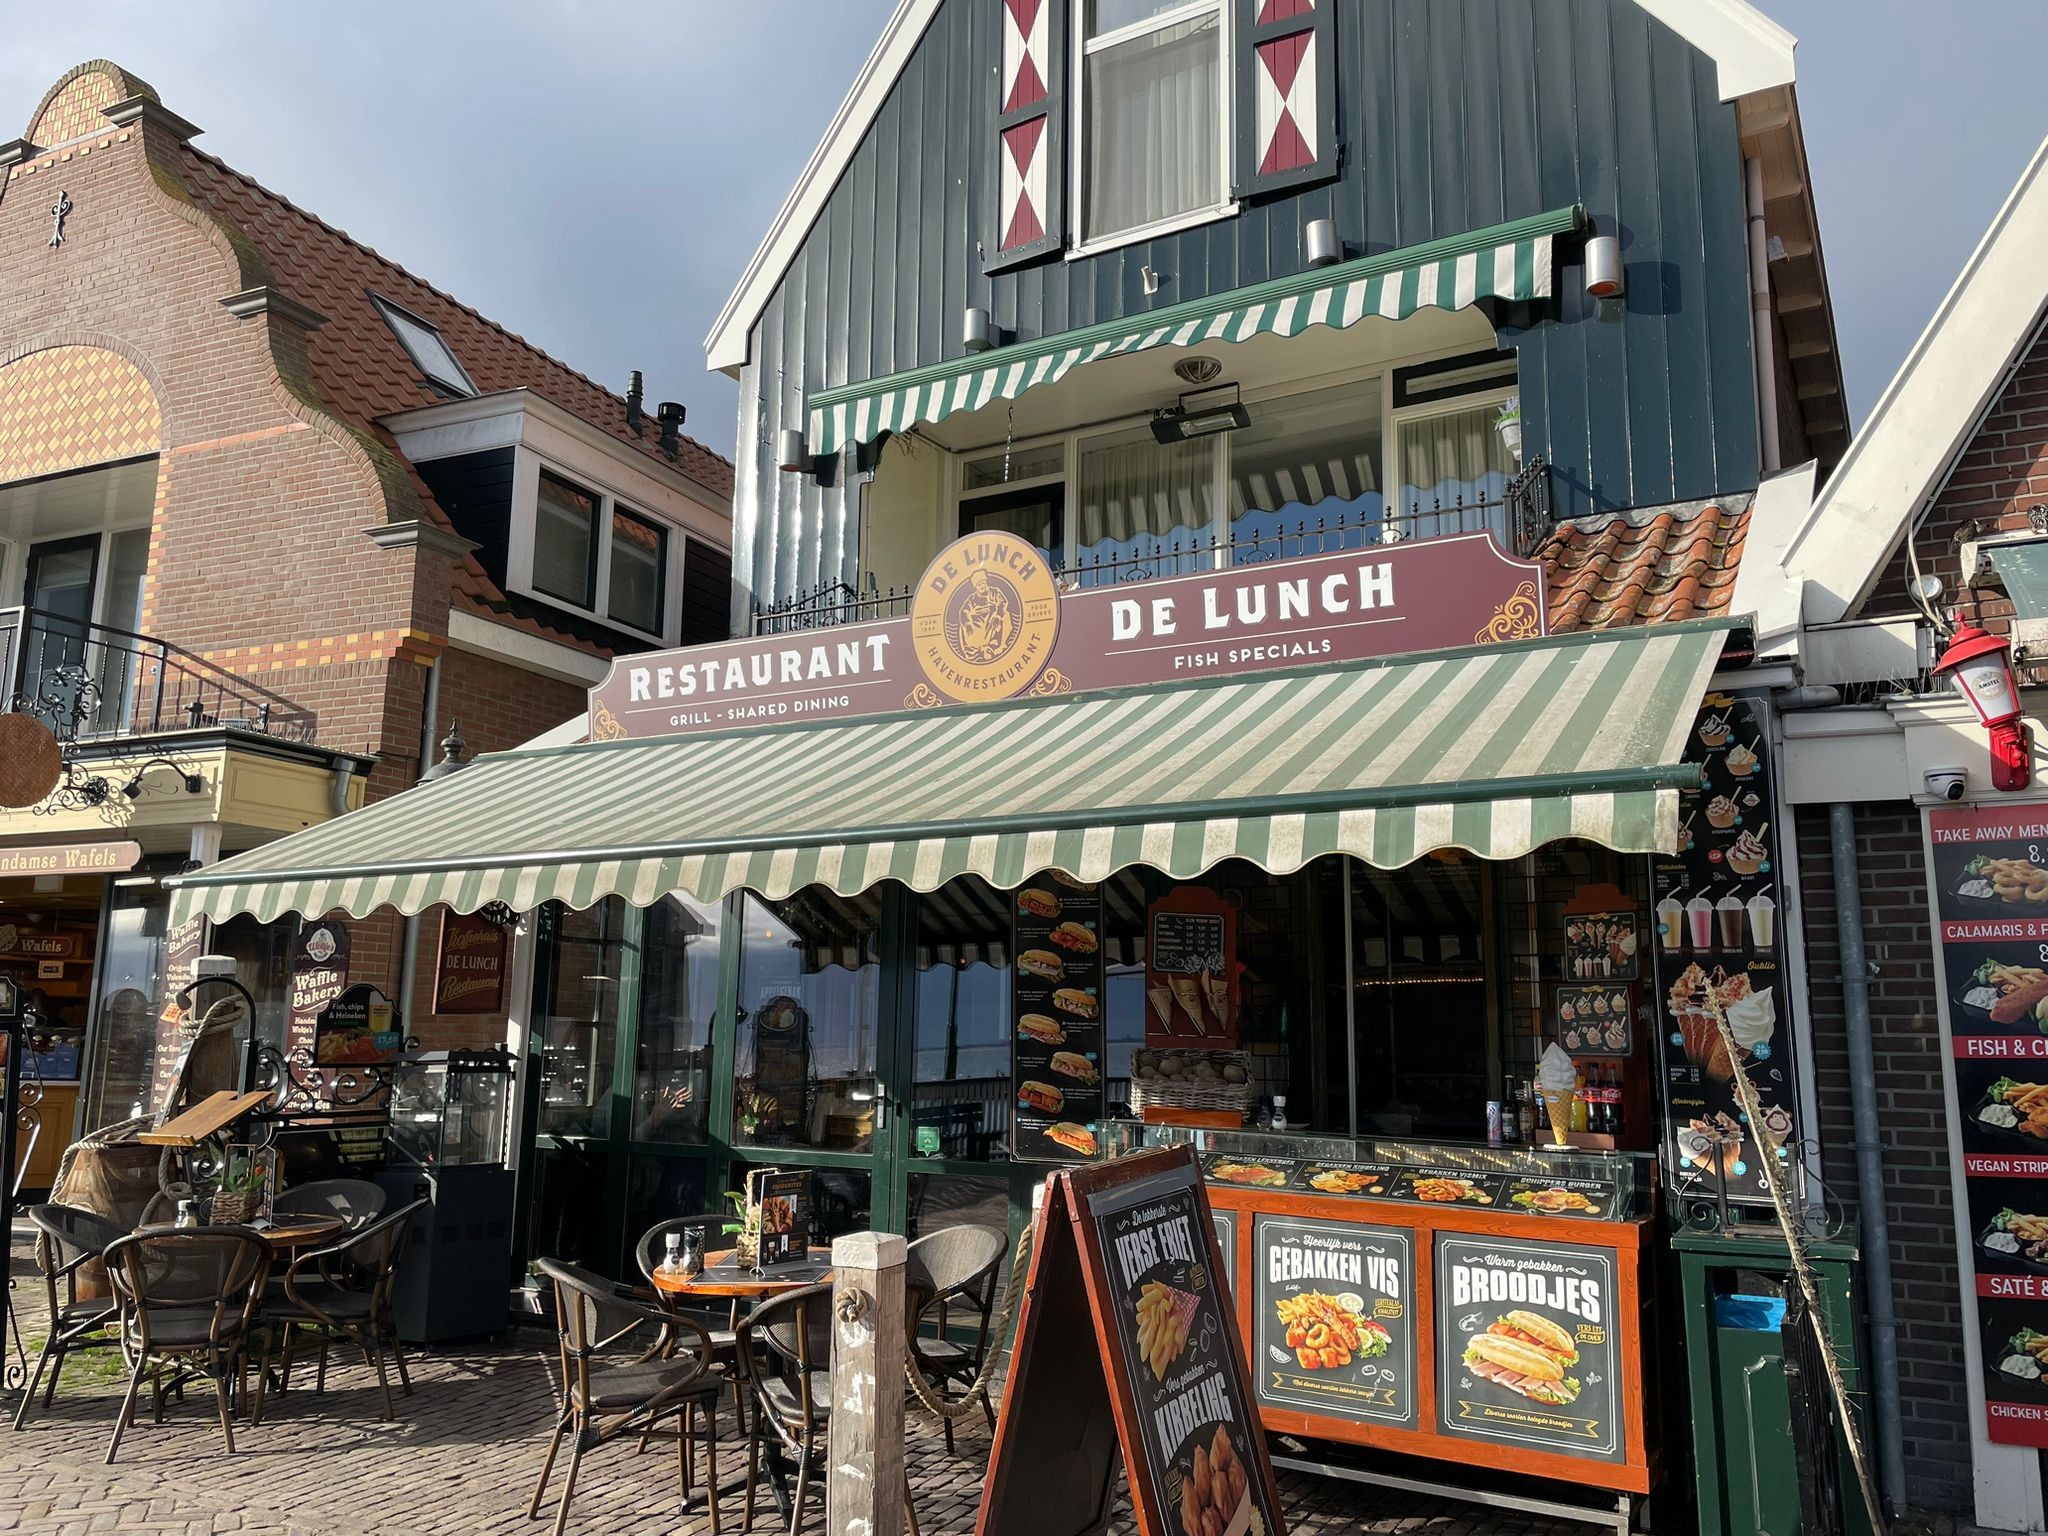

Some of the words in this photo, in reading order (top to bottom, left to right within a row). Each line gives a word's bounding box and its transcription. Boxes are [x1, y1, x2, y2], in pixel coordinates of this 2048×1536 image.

[930, 561, 958, 595] DE
[963, 543, 1037, 582] LUNCH
[1110, 597, 1178, 641] DE
[1203, 562, 1396, 630] LUNCH
[928, 633, 1041, 690] HAVENRESTAURANT
[1174, 652, 1220, 670] FISH
[1229, 639, 1332, 664] SPECIALS
[628, 634, 892, 702] RESTAURANT
[1979, 679, 2000, 689] AMSTEL
[669, 708, 712, 727] GRILL
[727, 702, 788, 721] SHARED
[794, 694, 850, 714] DINING
[1935, 828, 1970, 842] TAKE
[1975, 826, 2013, 840] AWAY
[64, 848, 117, 868] Wafels
[1946, 924, 2023, 938] CALAMARIS
[2027, 924, 2036, 936] &
[21, 939, 62, 953] Wafels
[168, 929, 201, 954] Bakery
[446, 955, 460, 969] DE
[462, 955, 499, 971] LUNCH
[295, 970, 338, 991] Waffle
[292, 984, 342, 1009] Bakery
[335, 1011, 366, 1019] Heineken
[347, 1003, 365, 1012] chips
[1967, 1039, 2007, 1056] FISH
[2013, 1039, 2026, 1056] &
[2031, 1039, 2048, 1056] C
[1418, 1168, 1458, 1177] GEBAKKEN
[1459, 1172, 1488, 1180] VISMIX
[1967, 1159, 2010, 1172] VEGAN
[2013, 1160, 2048, 1173] STRIP
[1520, 1177, 1567, 1187] SCHIPPERS
[1567, 1181, 1602, 1190] BURGER
[1132, 1210, 1142, 1226] De
[1303, 1234, 1342, 1251] Heerlijk
[1342, 1242, 1362, 1251] vers
[1115, 1227, 1160, 1291] VERSE
[1157, 1215, 1197, 1264] FRIET
[1484, 1253, 1516, 1268] Warm
[1516, 1258, 1565, 1273] gebakken
[1269, 1245, 1362, 1285] GEBAKKEN
[1366, 1255, 1399, 1299] VIS
[1452, 1264, 1601, 1324] BROODJES
[1990, 1274, 2035, 1296] SATÉ
[1153, 1371, 1234, 1469] KIBBELING
[1991, 1405, 2041, 1420] CHICKEN
[1549, 1418, 1574, 1429] broodjes
